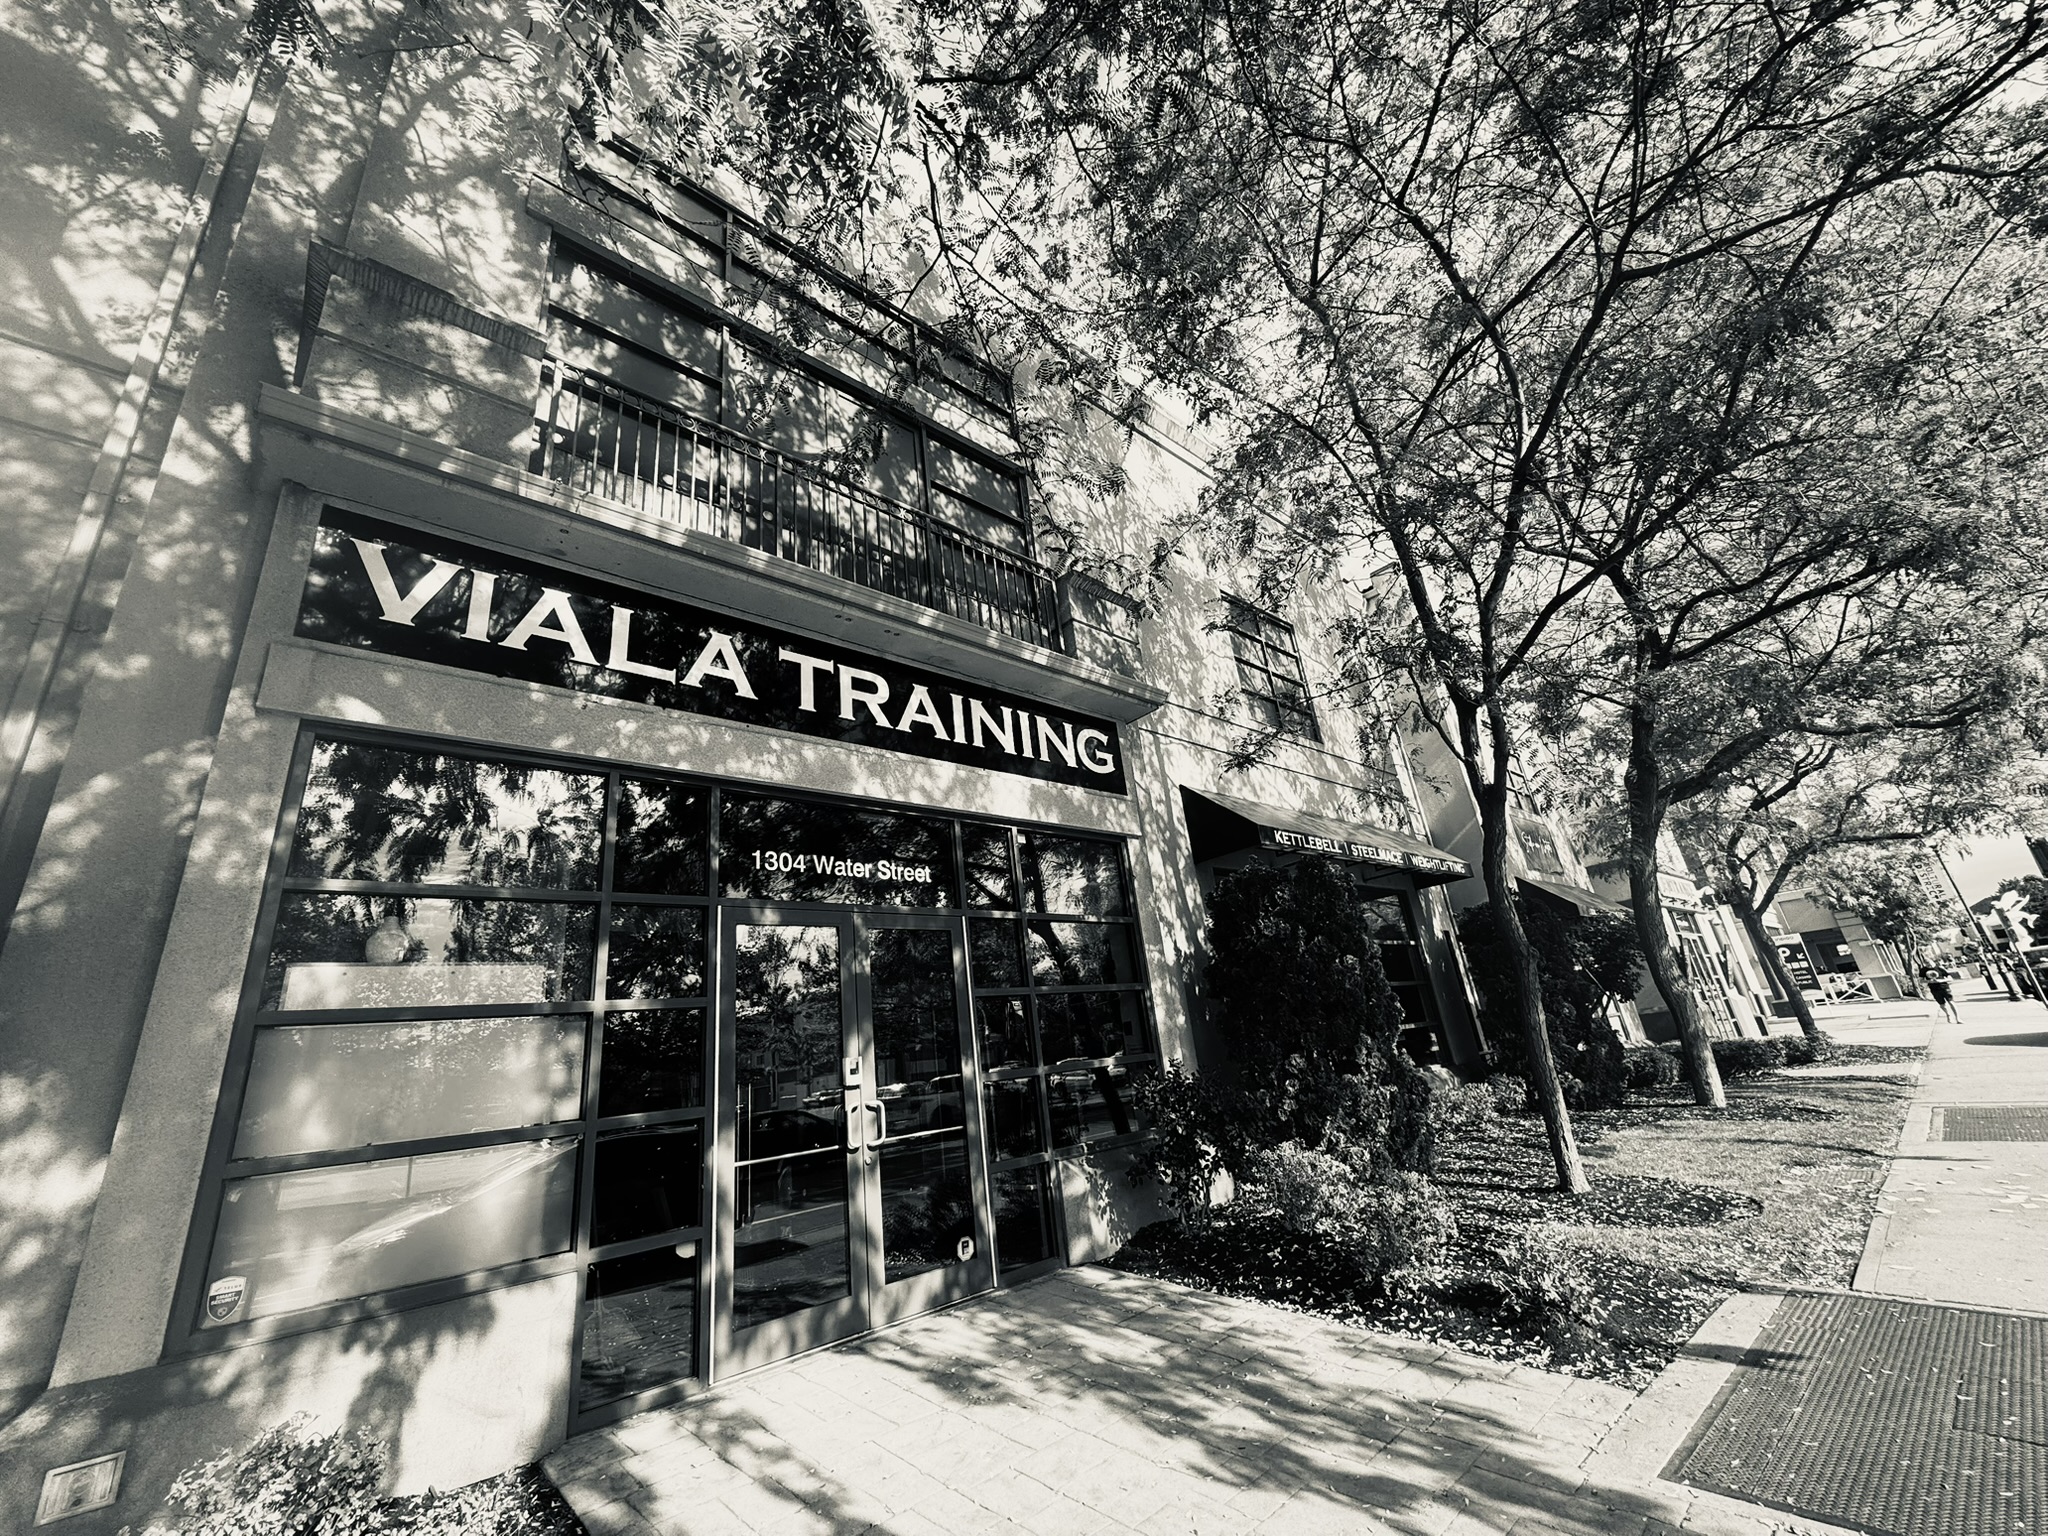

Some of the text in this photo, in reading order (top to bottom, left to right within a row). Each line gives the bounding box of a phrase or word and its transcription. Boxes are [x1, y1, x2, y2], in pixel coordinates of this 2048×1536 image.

[348, 538, 1117, 776] VIALA TRAINING
[752, 850, 932, 883] 1304 Water Street
[1274, 830, 1466, 874] KETTLEBELL STEELMACE WEIGHTLIFTING
